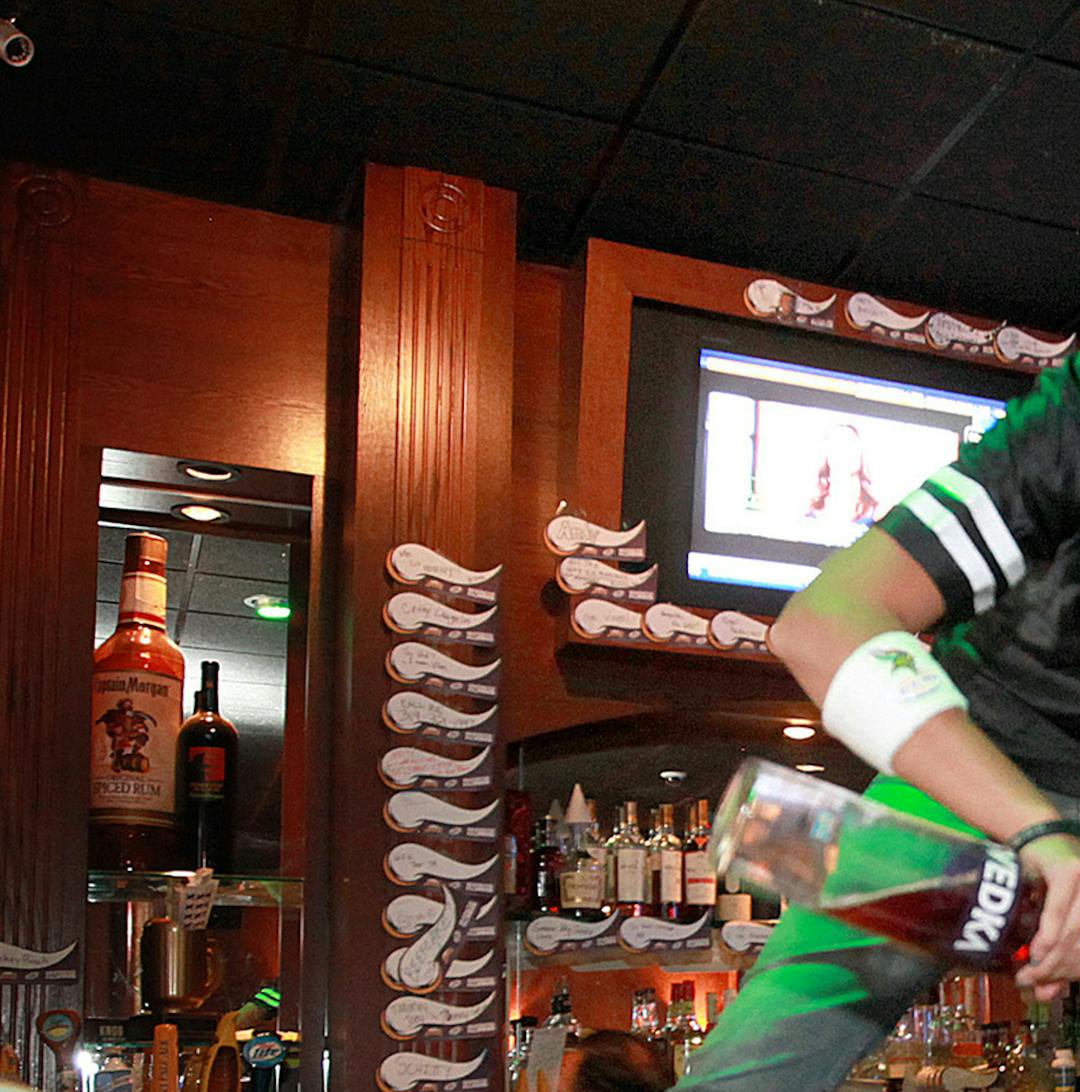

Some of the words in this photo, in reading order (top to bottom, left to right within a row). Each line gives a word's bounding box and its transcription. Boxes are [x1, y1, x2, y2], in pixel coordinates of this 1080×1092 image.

[96, 677, 126, 696] aptain
[126, 676, 169, 698] Morgan
[133, 782, 162, 797] RUM
[251, 1047, 281, 1060] Lite
